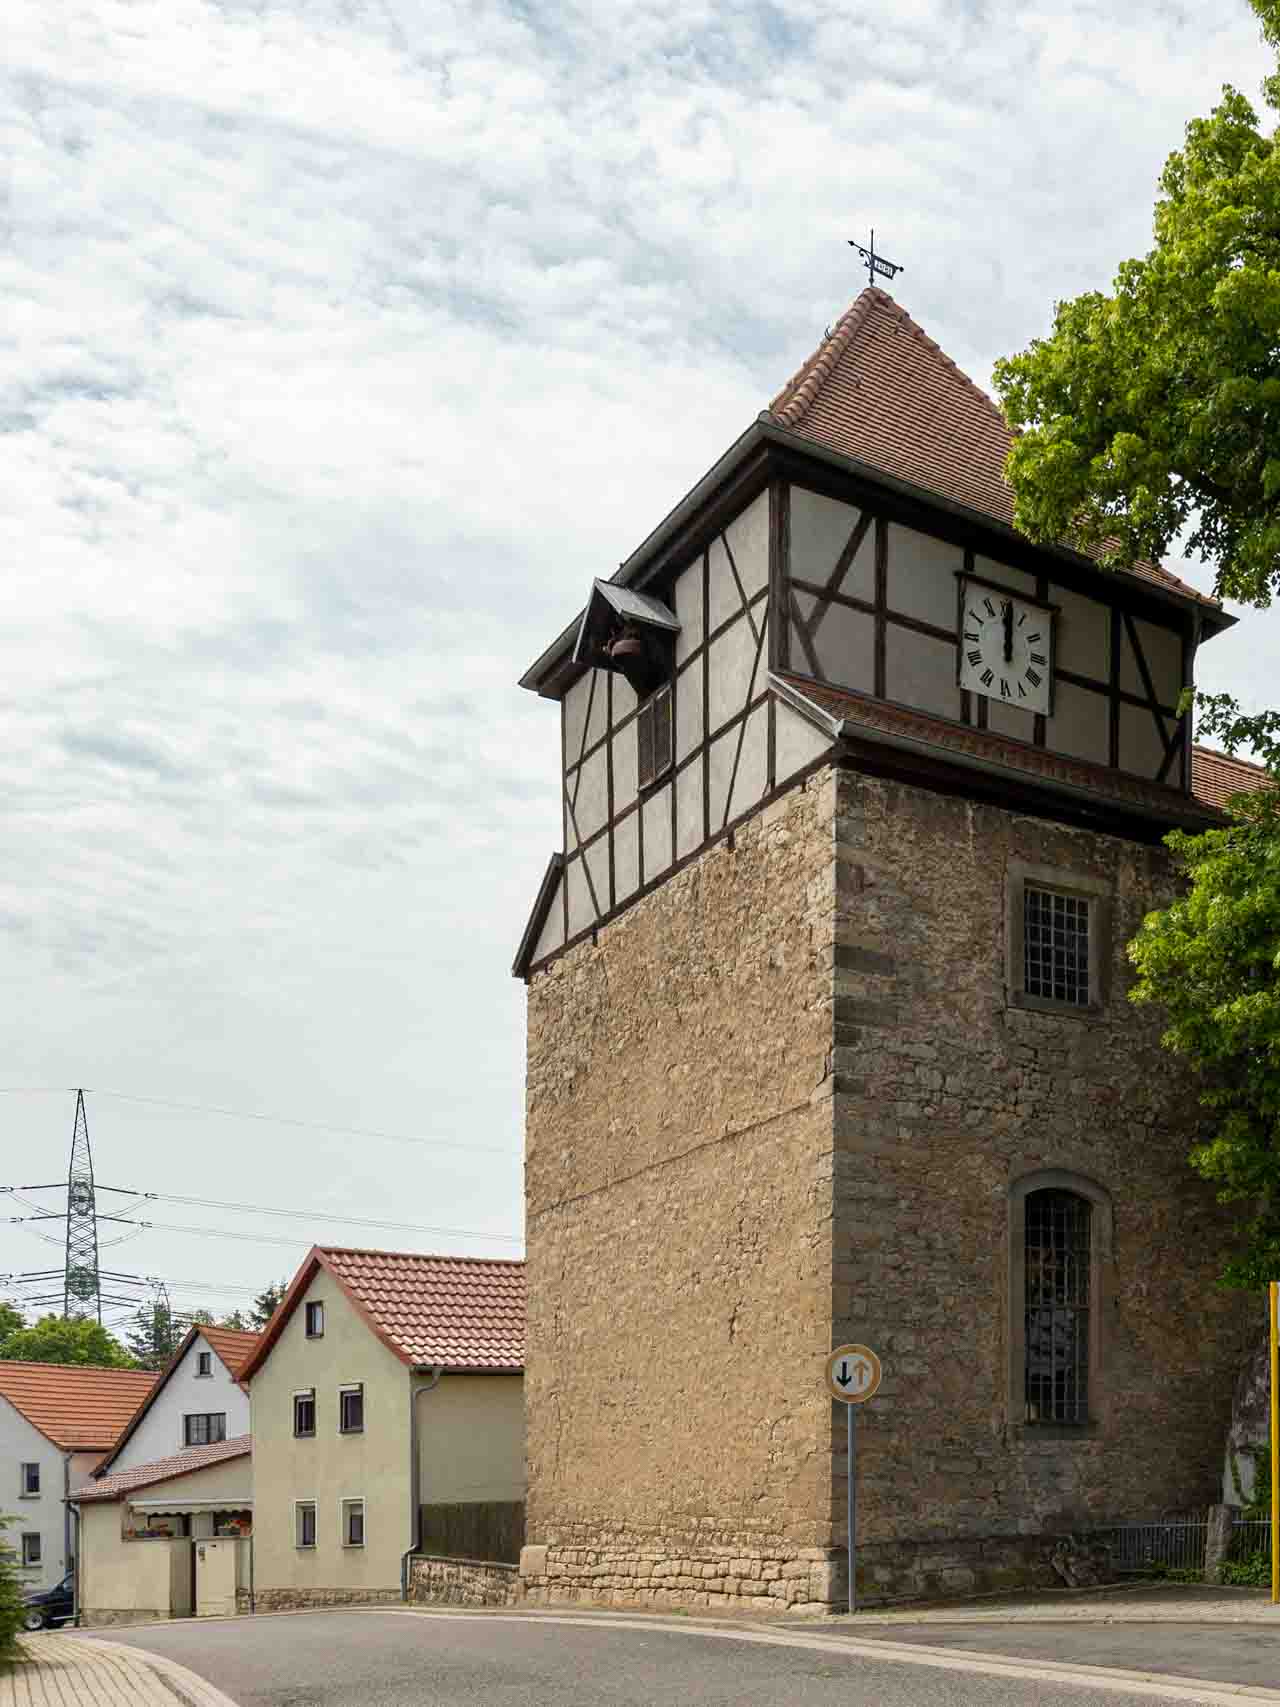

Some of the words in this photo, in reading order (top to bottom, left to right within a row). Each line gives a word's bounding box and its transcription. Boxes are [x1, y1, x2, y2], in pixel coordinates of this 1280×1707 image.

[1017, 613, 1026, 627] I
[1026, 633, 1041, 643] II
[1030, 652, 1048, 666] III
[1017, 680, 1027, 697] V
